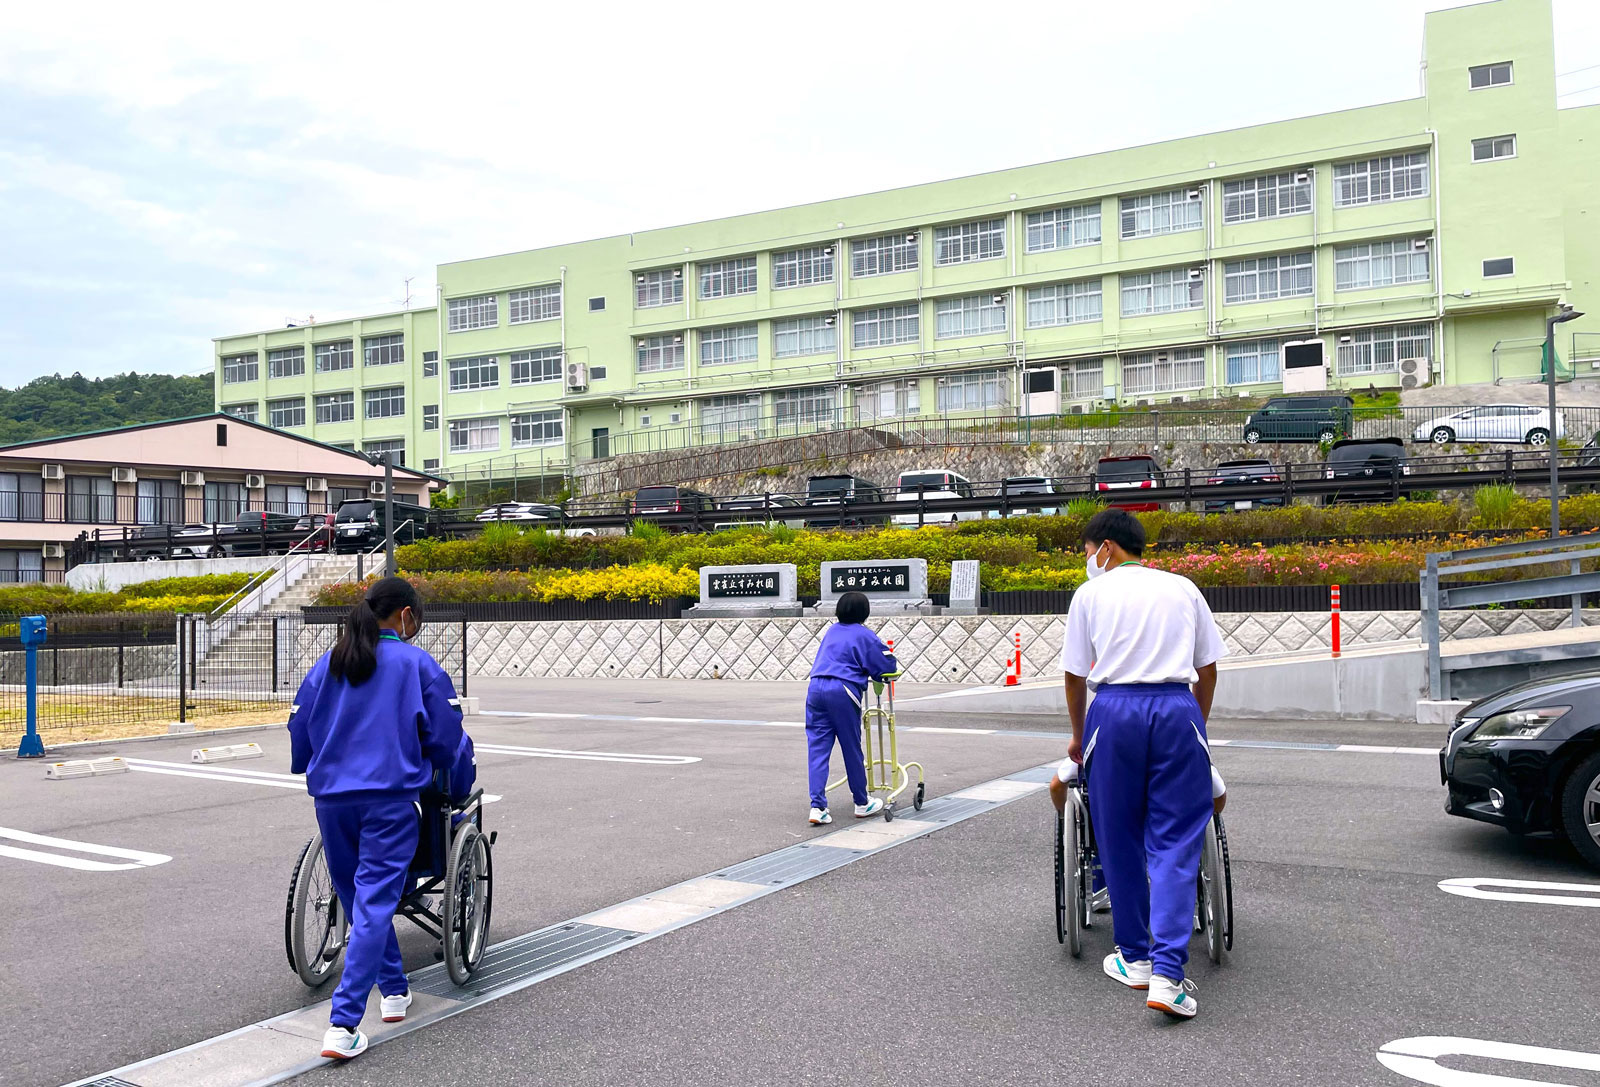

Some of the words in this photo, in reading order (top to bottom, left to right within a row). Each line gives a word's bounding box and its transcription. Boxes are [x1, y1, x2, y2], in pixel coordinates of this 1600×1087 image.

[834, 574, 905, 588] 長田すみれ園
